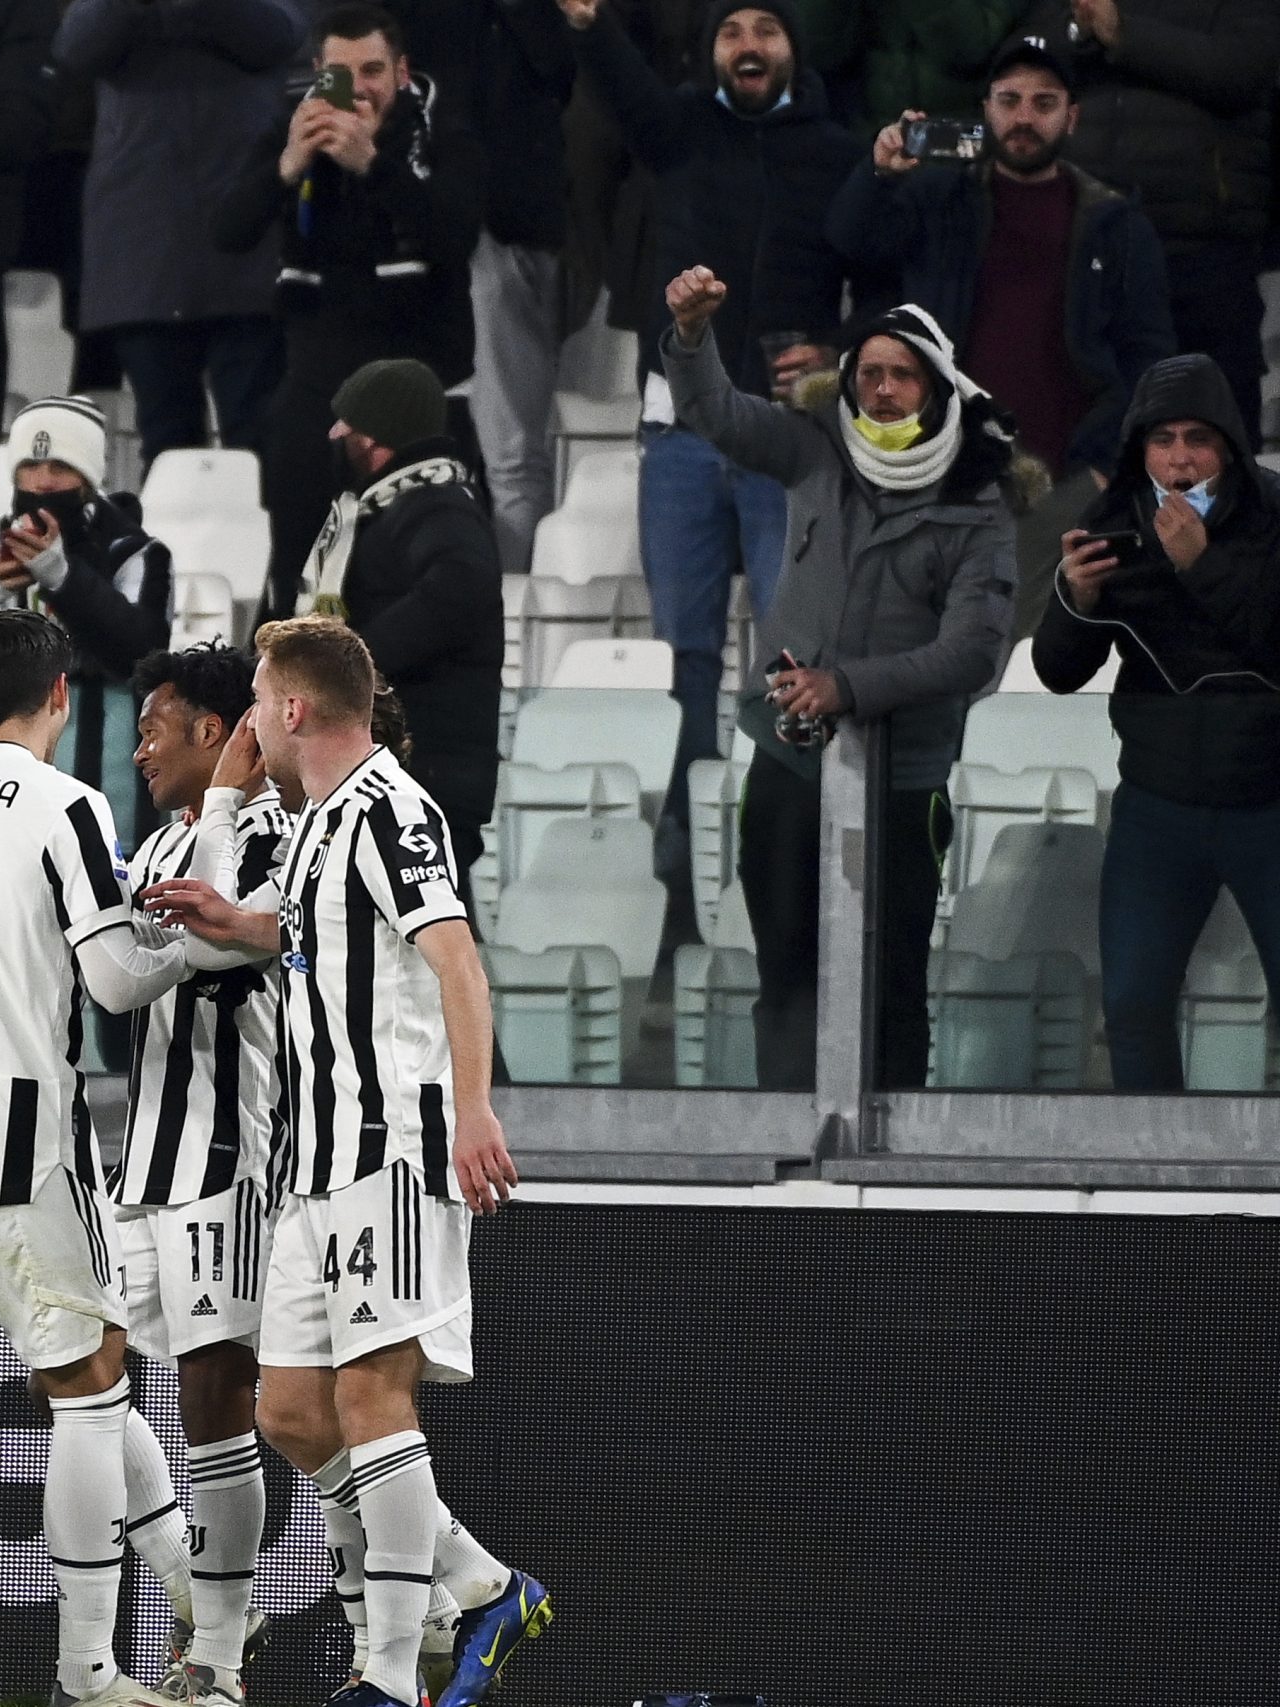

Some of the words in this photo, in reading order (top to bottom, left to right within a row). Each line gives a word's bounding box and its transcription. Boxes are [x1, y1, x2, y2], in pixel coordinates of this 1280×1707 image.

[400, 864, 448, 885] Bitg
[186, 1222, 224, 1282] 11
[323, 1226, 377, 1293] 44
